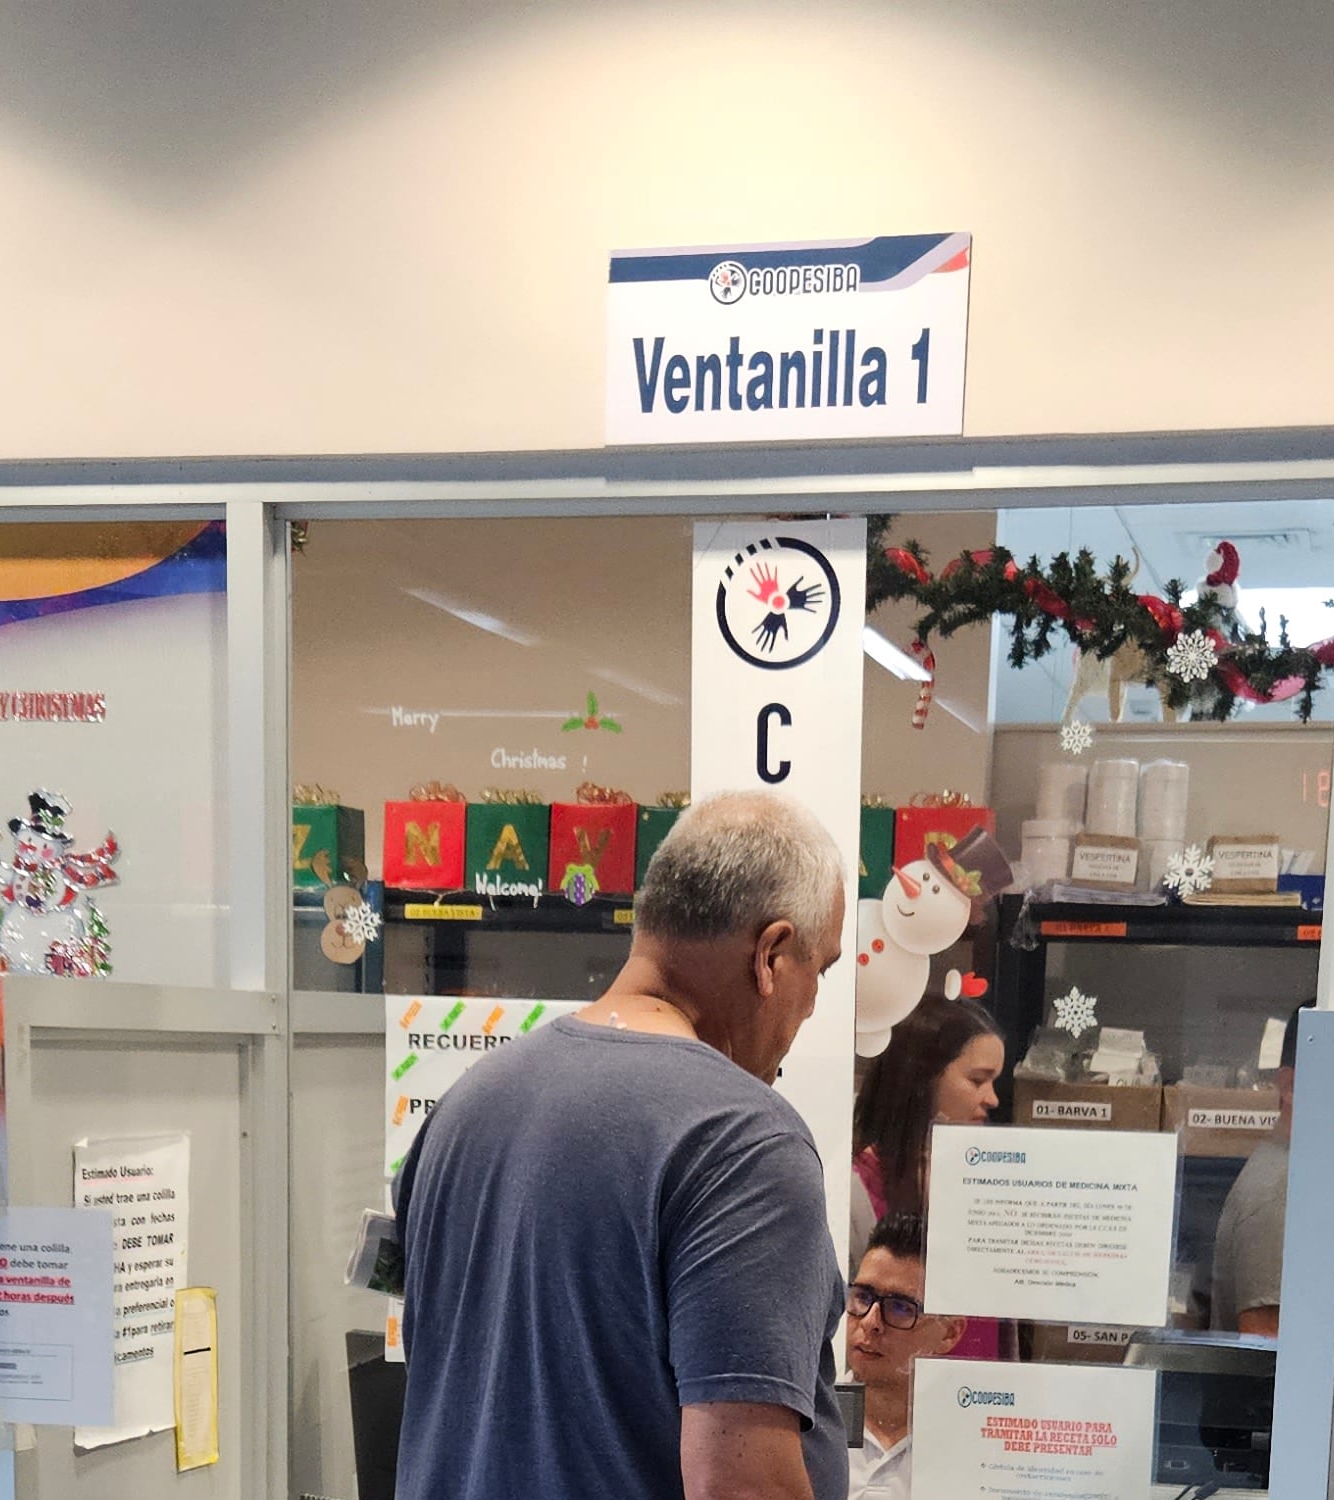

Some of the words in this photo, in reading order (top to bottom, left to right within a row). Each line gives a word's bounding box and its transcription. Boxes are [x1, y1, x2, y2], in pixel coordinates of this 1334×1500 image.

[749, 265, 858, 296] COOPESIBA
[632, 328, 888, 414] Ventanilla
[911, 328, 930, 404] 1
[392, 706, 439, 734] Merry
[491, 748, 566, 769] Christmas
[1080, 852, 1130, 863] VESPERTINA
[1219, 851, 1272, 860] VESPERTINA
[1036, 1107, 1055, 1116] 01-
[1058, 1106, 1097, 1117] BARVA
[1193, 1115, 1212, 1124] 02-
[1215, 1115, 1255, 1125] BUENA
[122, 1236, 142, 1250] DEBE
[147, 1233, 174, 1247] TOMAR
[9, 1258, 35, 1269] debe
[37, 1260, 69, 1270] tomar
[1073, 1330, 1091, 1342] 05-
[1093, 1332, 1117, 1343] SAN
[987, 1416, 1037, 1430] ESTIMADO
[1041, 1420, 1082, 1432] USUARIO
[1085, 1422, 1112, 1433] PARA
[980, 1427, 1033, 1441] TRAMITAR
[1035, 1431, 1047, 1441] LA
[1050, 1432, 1088, 1444] RECETA
[1091, 1435, 1117, 1446] SOLO
[1004, 1441, 1031, 1453] DEBE
